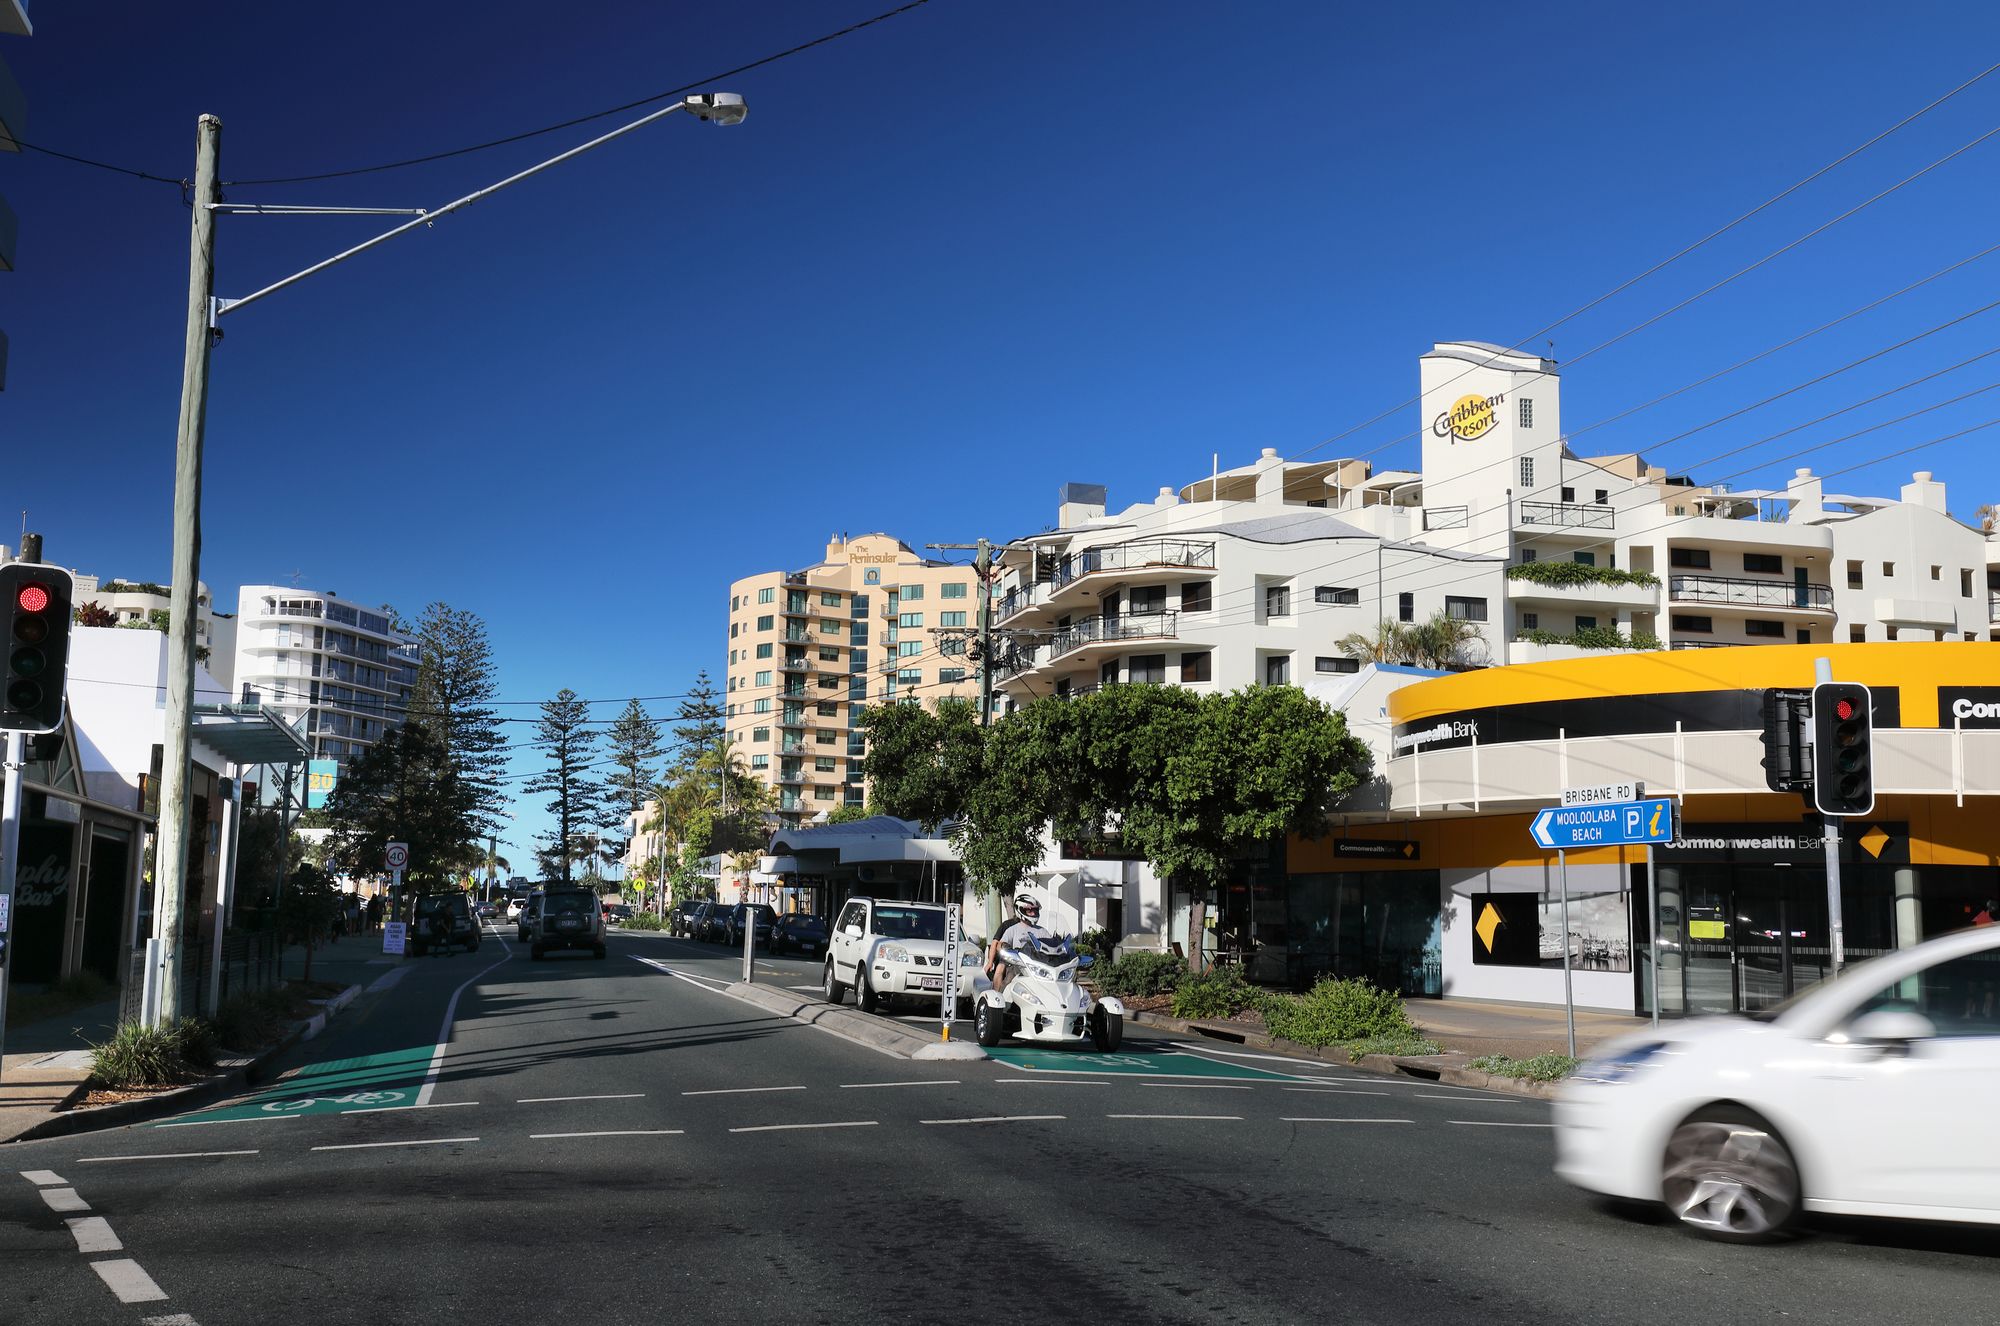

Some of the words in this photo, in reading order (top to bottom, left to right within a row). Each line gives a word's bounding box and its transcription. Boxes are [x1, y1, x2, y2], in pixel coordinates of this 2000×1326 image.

[1433, 393, 1504, 437] Caribbean
[1450, 411, 1499, 445] Resort
[849, 552, 897, 563] Peninsular
[1453, 719, 1479, 738] Bank
[1566, 787, 1612, 803] BRISBANE
[1618, 785, 1630, 798] RD
[1556, 809, 1617, 826] MOOLOOLABA
[1627, 810, 1640, 835] P
[1572, 827, 1602, 841] BEACH
[390, 851, 404, 861] 40
[948, 907, 956, 954] KEEP
[946, 960, 954, 1007] LEFT
